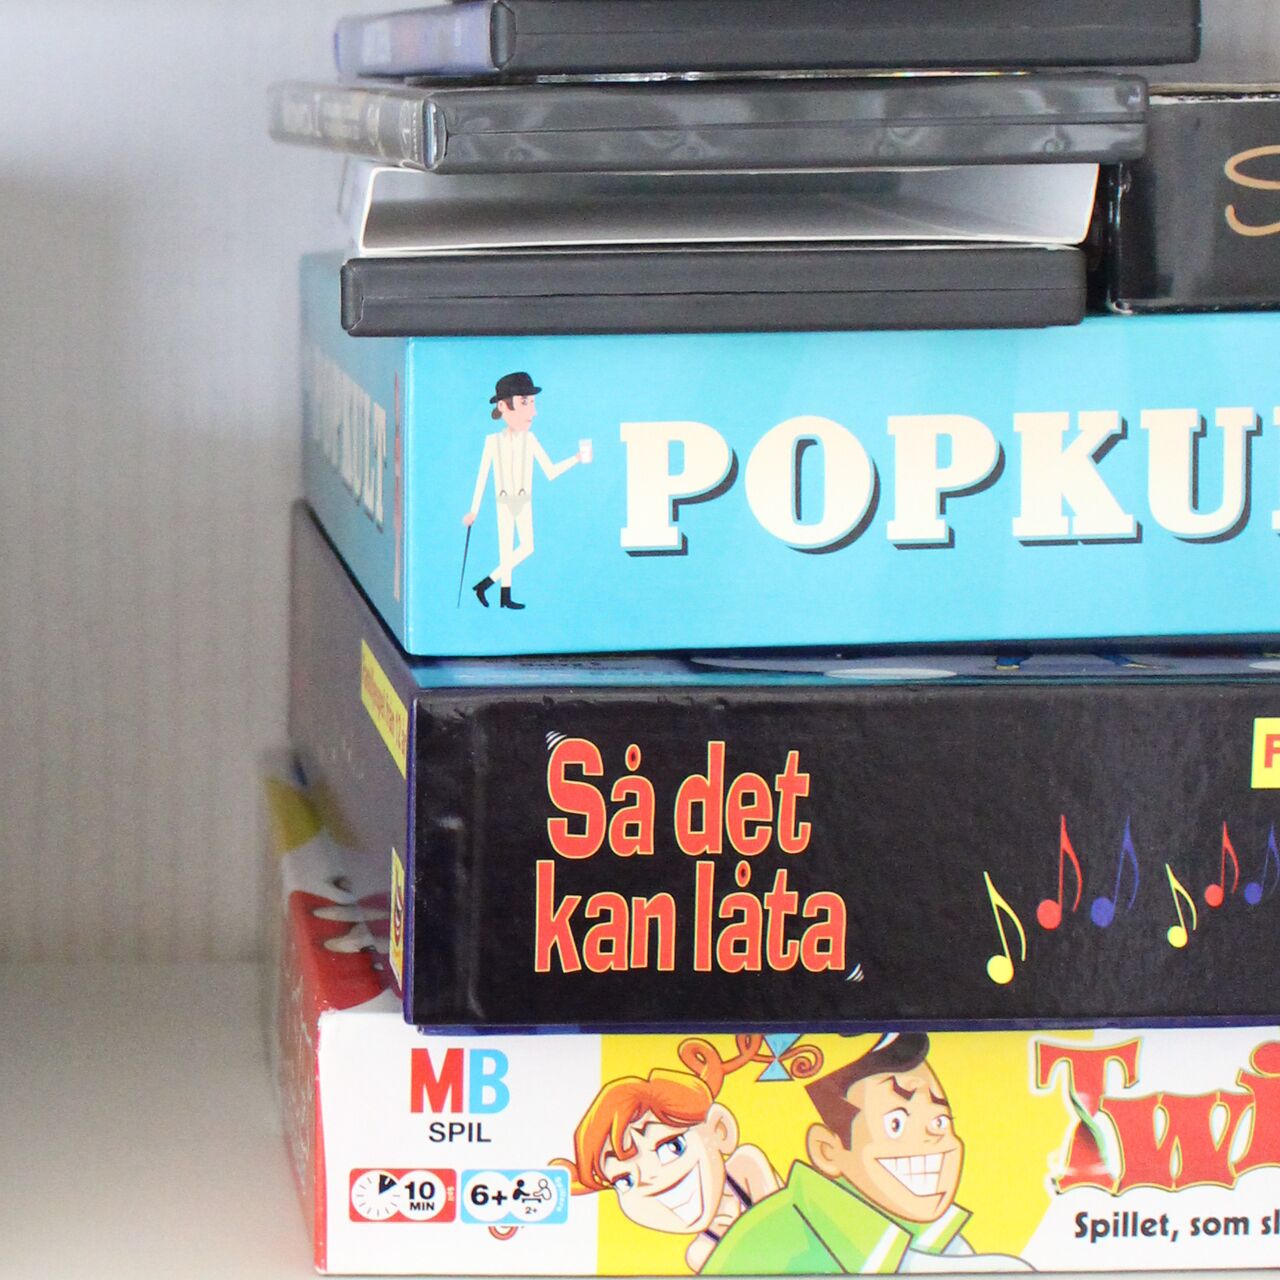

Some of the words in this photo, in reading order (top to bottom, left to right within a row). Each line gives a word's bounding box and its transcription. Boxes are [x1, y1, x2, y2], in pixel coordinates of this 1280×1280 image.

[620, 405, 1280, 555] POPKU
[546, 736, 658, 860] Så
[674, 740, 813, 858] det
[534, 859, 677, 976] kan
[693, 858, 849, 976] låta
[410, 1047, 510, 1115] MB
[428, 1122, 492, 1144] SPIL
[404, 1181, 435, 1201] 10
[408, 1201, 436, 1213] MIN
[469, 1185, 508, 1206] 6+
[1074, 1210, 1180, 1243] Spillet,
[1189, 1213, 1250, 1238] som
